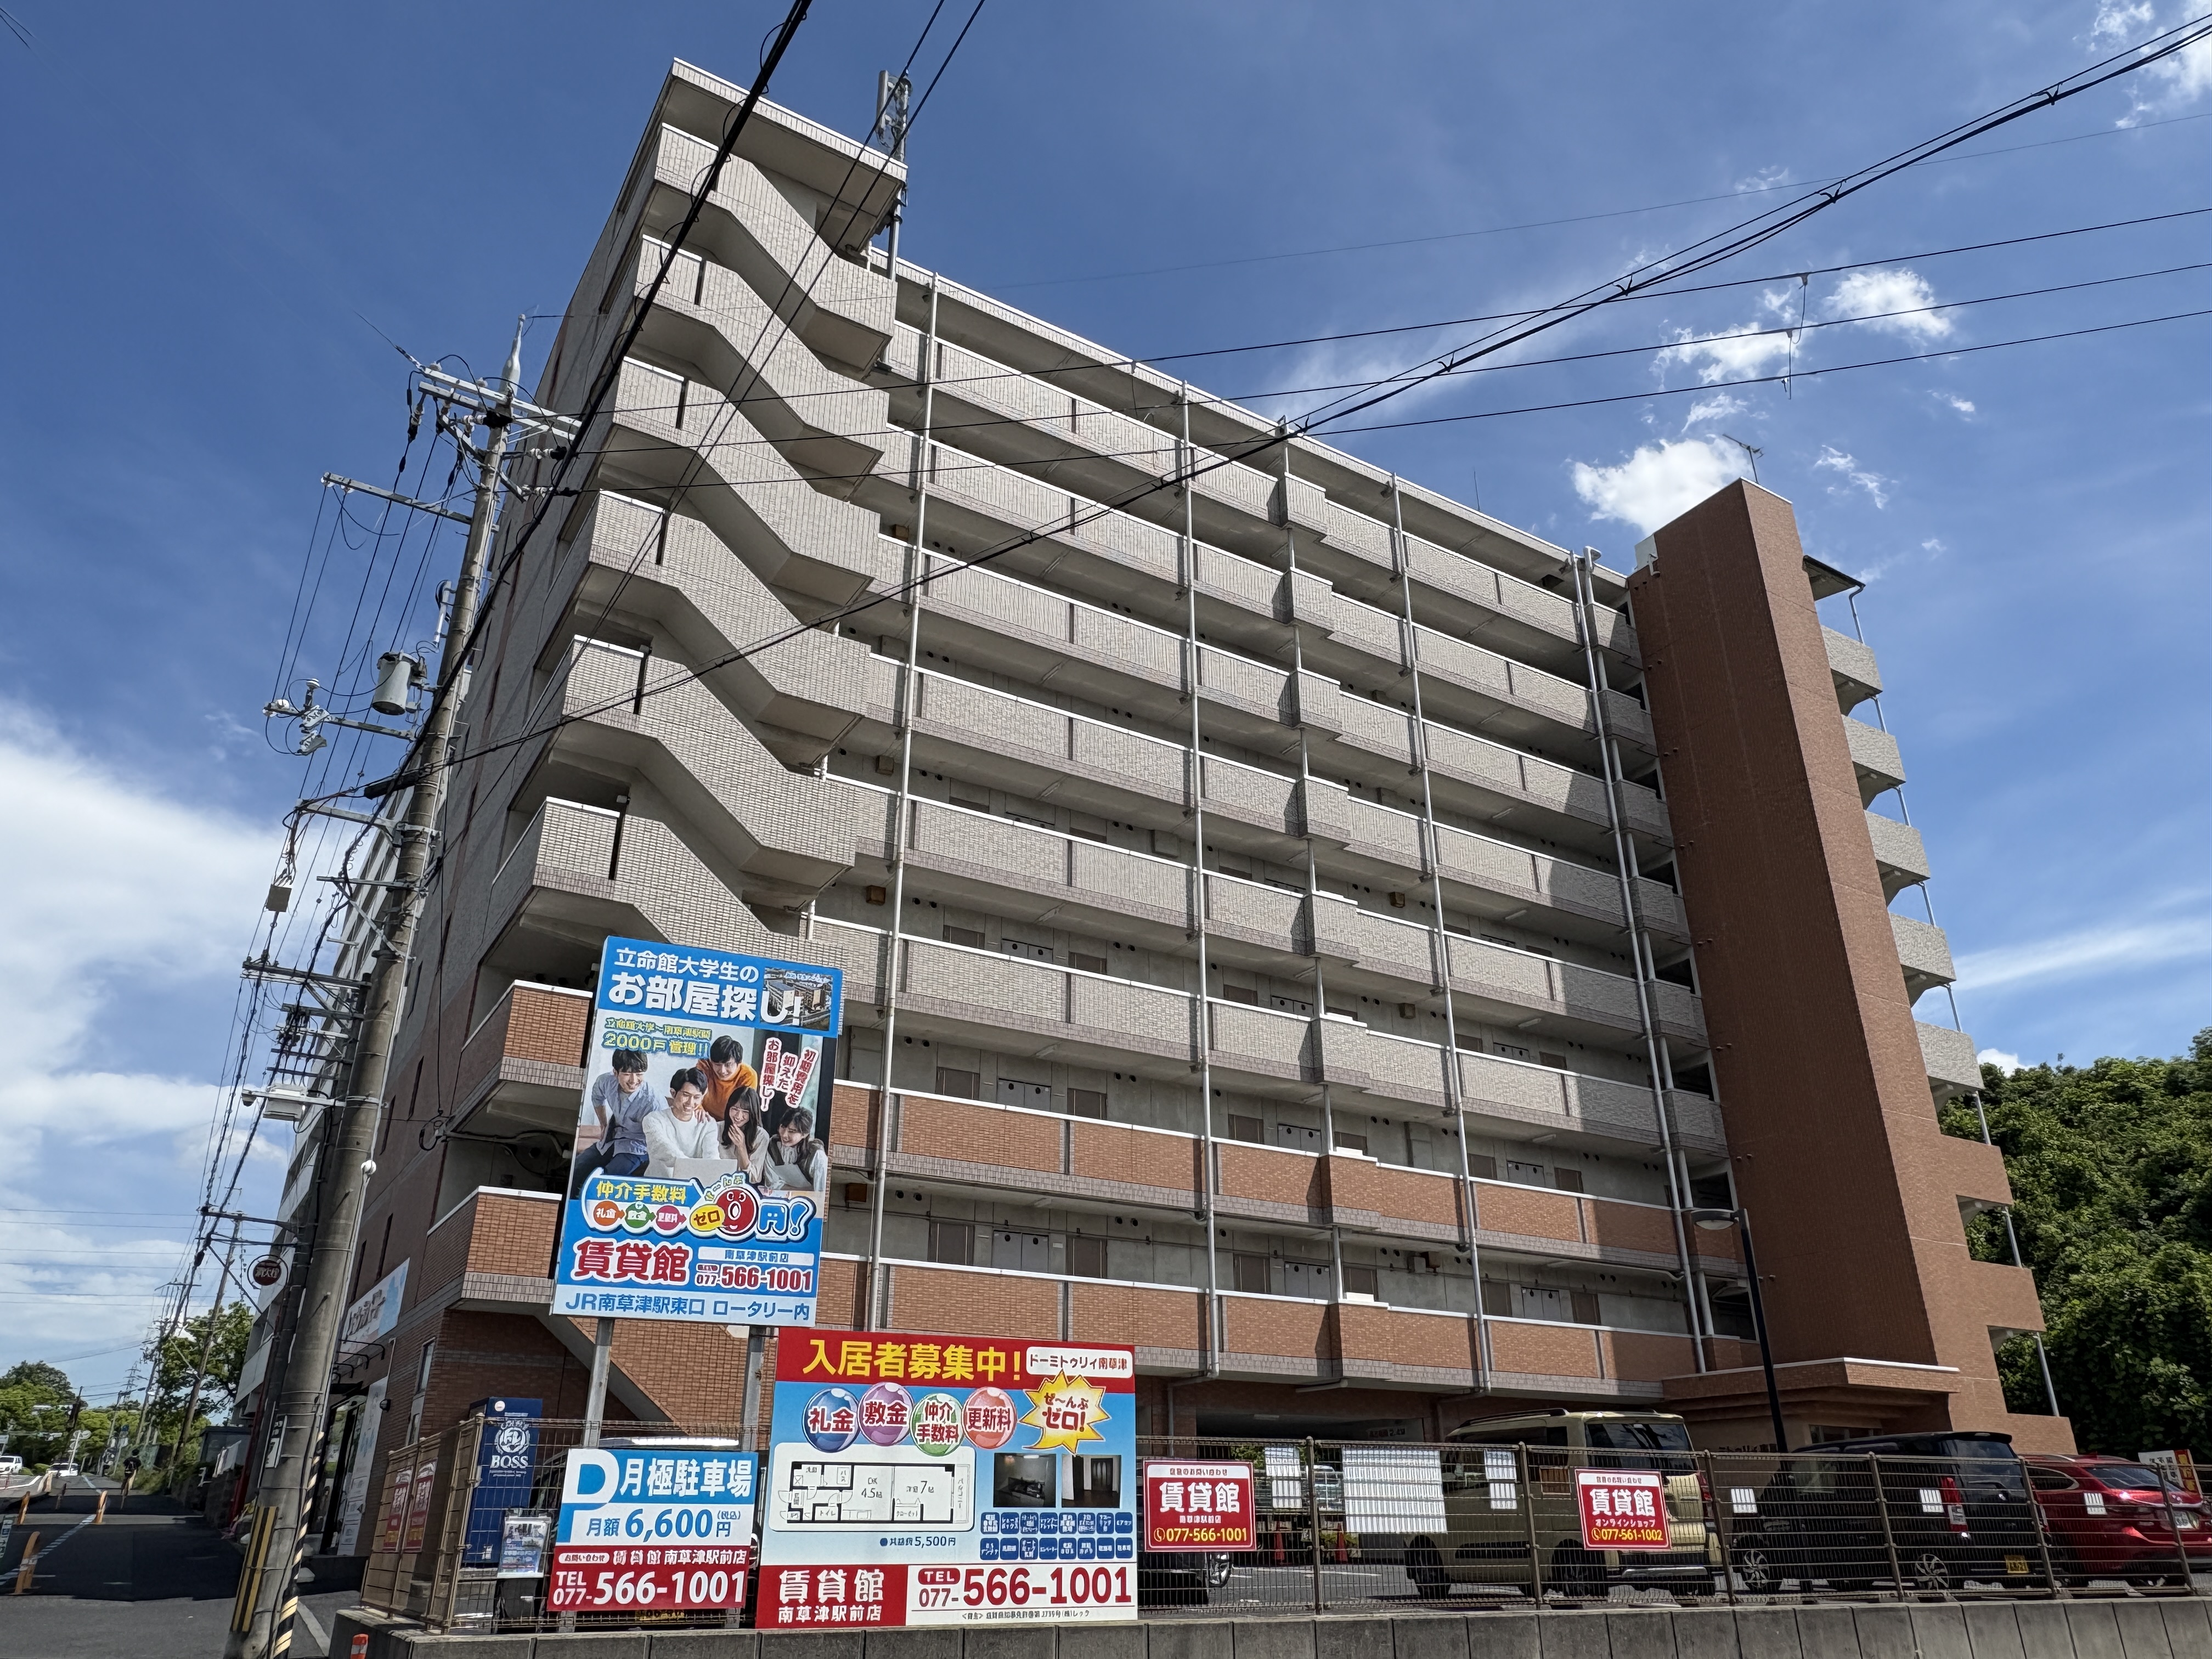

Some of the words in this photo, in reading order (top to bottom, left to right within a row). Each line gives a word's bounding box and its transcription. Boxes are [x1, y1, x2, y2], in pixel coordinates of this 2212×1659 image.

[614, 947, 759, 983] 立命館大学生の
[608, 972, 803, 1026] お部屋探し!
[596, 1180, 686, 1205] 仲介手数料
[693, 1210, 721, 1227] ゼロ
[574, 1240, 690, 1282] 賃貸館
[566, 1293, 706, 1316] JR南草津駅東口
[713, 1300, 810, 1321] ロータリー内
[802, 1339, 1021, 1382] 入居者募集中!
[809, 1407, 854, 1432] 礼金
[864, 1401, 908, 1425] 敷金
[924, 1402, 953, 1421] 仲介
[967, 1408, 1011, 1431] 更新料
[1042, 1407, 1086, 1432] ゼロ!
[916, 1424, 959, 1443] 手数料
[490, 1455, 529, 1469] BOSS
[619, 1458, 753, 1497] 月極駐車場
[556, 1448, 619, 1543] P
[1159, 1482, 1240, 1513] 賃貸館
[1590, 1488, 1656, 1517] 賃貸館
[664, 1549, 747, 1565] 南草津駅前店
[556, 1571, 587, 1586] TEL
[779, 1568, 884, 1604] 賃貸館
[924, 1571, 955, 1582] TEL
[778, 1604, 882, 1624] 南草津駅前店
